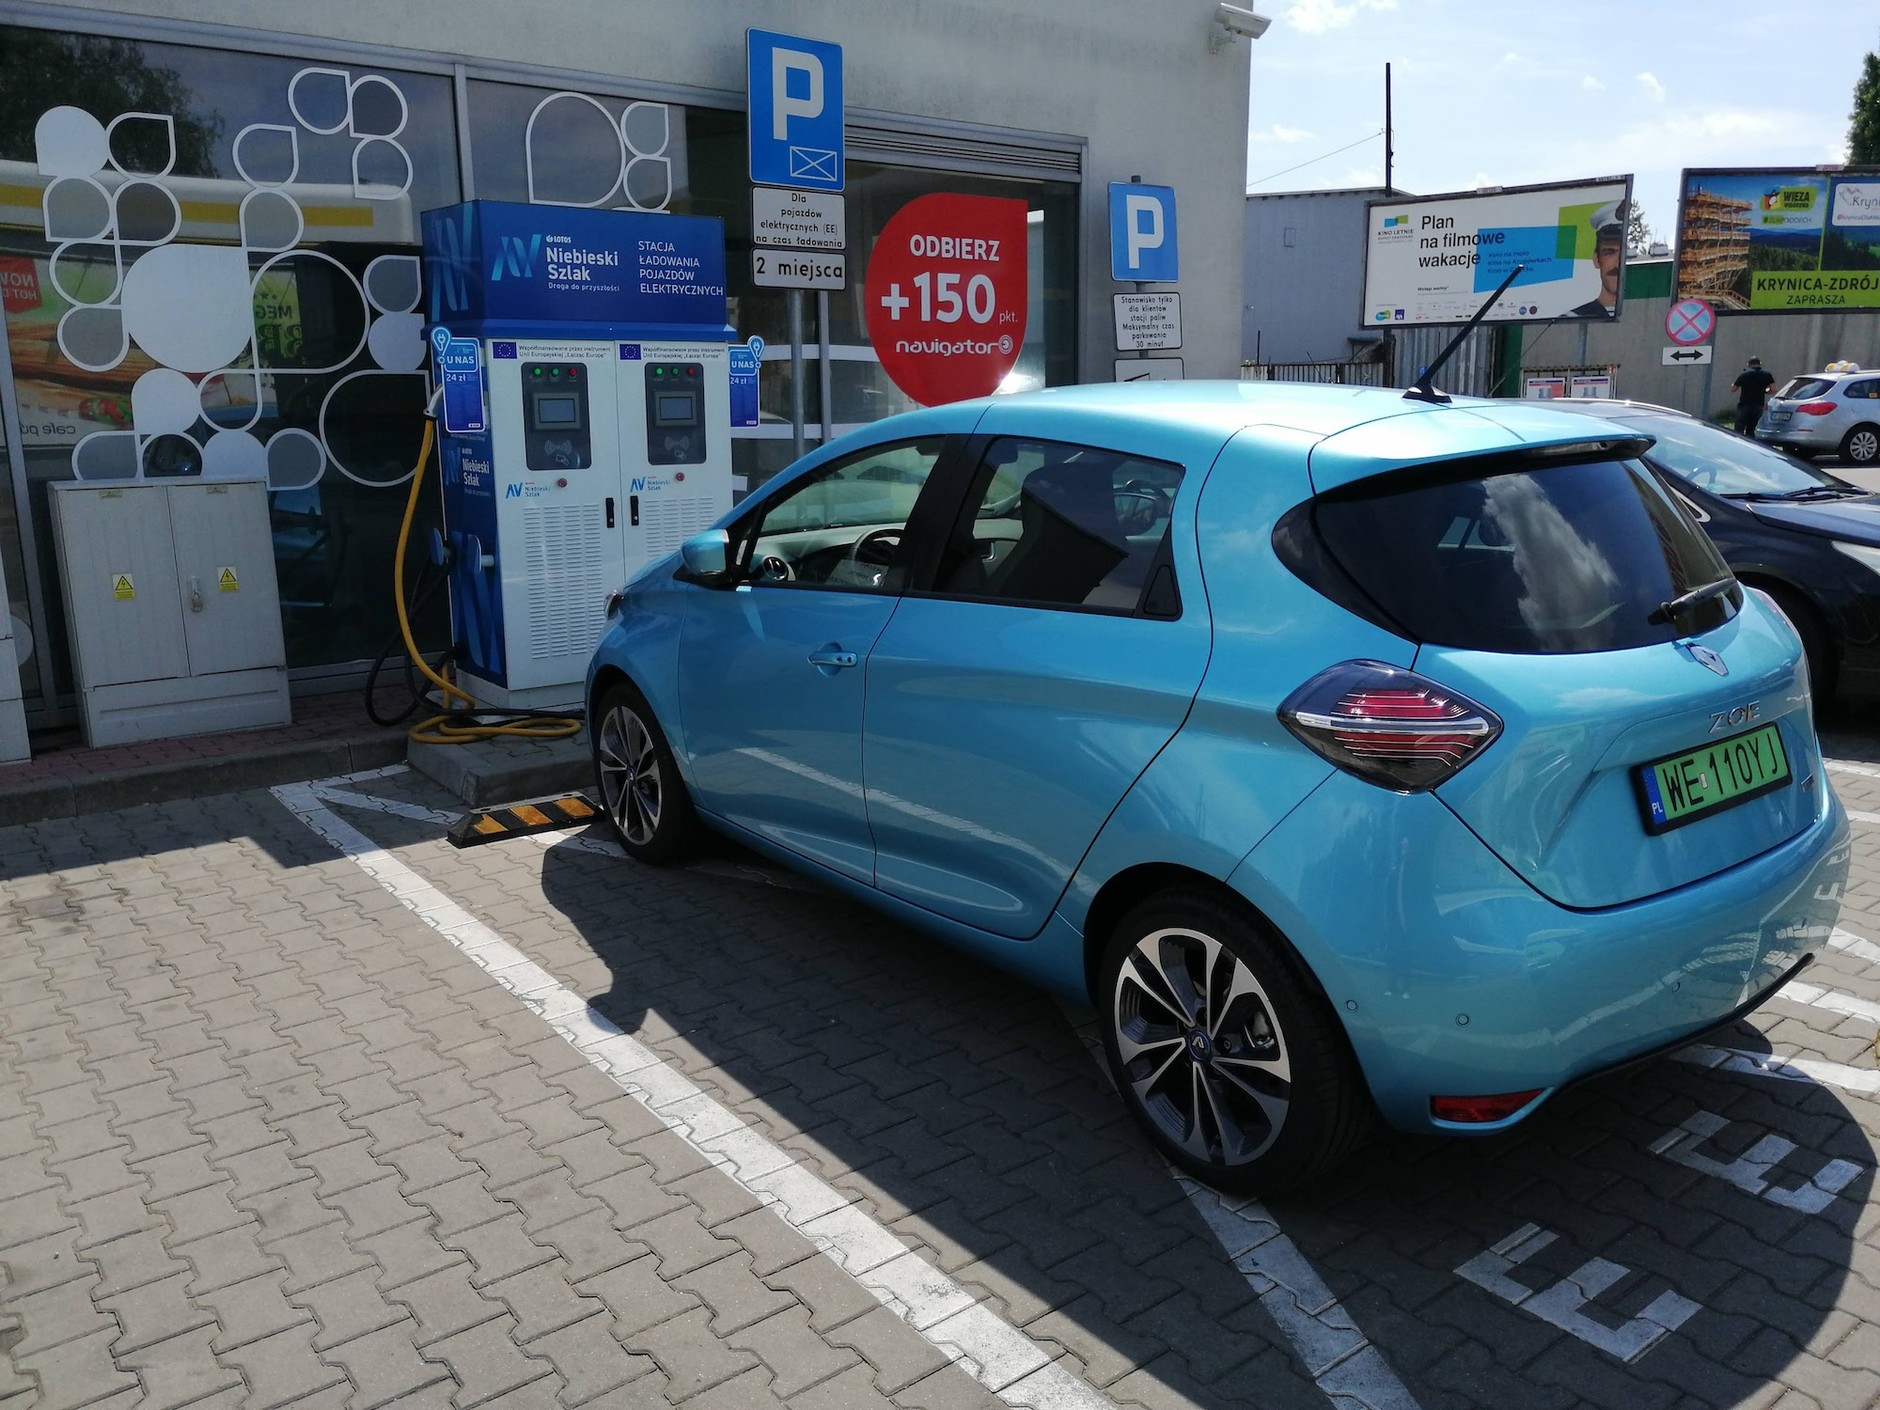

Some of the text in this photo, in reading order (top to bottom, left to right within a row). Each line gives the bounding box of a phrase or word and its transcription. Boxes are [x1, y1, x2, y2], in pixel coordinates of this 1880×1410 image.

[772, 47, 824, 141] P
[791, 193, 807, 203] Dla
[781, 207, 822, 218] pojazdów
[760, 220, 838, 235] elektrycznych (EE)
[1421, 215, 1454, 230] Plan
[1126, 194, 1164, 269] P
[638, 240, 675, 252] STACJA
[796, 236, 842, 248] ładowania
[1420, 231, 1505, 249] na filmowe
[910, 234, 1000, 262] ODBIERZ
[546, 247, 619, 266] Niebieski
[639, 255, 700, 268] ŁADOWANIA
[1419, 251, 1481, 269] wakacje
[548, 264, 591, 281] Szlak
[639, 267, 695, 281] POJAZDÓW
[756, 256, 843, 281] 2 miejsca
[548, 282, 569, 290] Droga
[581, 284, 620, 292] przyszłości
[640, 283, 724, 296] ELEKTRYCZNYCH
[1757, 274, 1879, 291] KRYNICA-ZDRÓJ
[881, 271, 1018, 324] +150 pkt.
[1121, 296, 1173, 304] Stanowisko tylko
[1786, 294, 1845, 305] ZAPRASZA
[1130, 314, 1166, 323] stacji paliw
[1122, 323, 1159, 331] Maksymalny
[1132, 332, 1167, 340] parkowania
[896, 338, 1000, 357] navigator
[447, 355, 475, 364] U NAS
[738, 361, 754, 369] NAS
[446, 373, 466, 382] 24 zł
[730, 377, 739, 385] 24
[462, 458, 490, 474] Niebieski
[463, 472, 480, 487] Szlak
[1708, 700, 1761, 734] ZOE
[1662, 733, 1778, 812] WE 110YJ
[1651, 801, 1664, 814] PL
